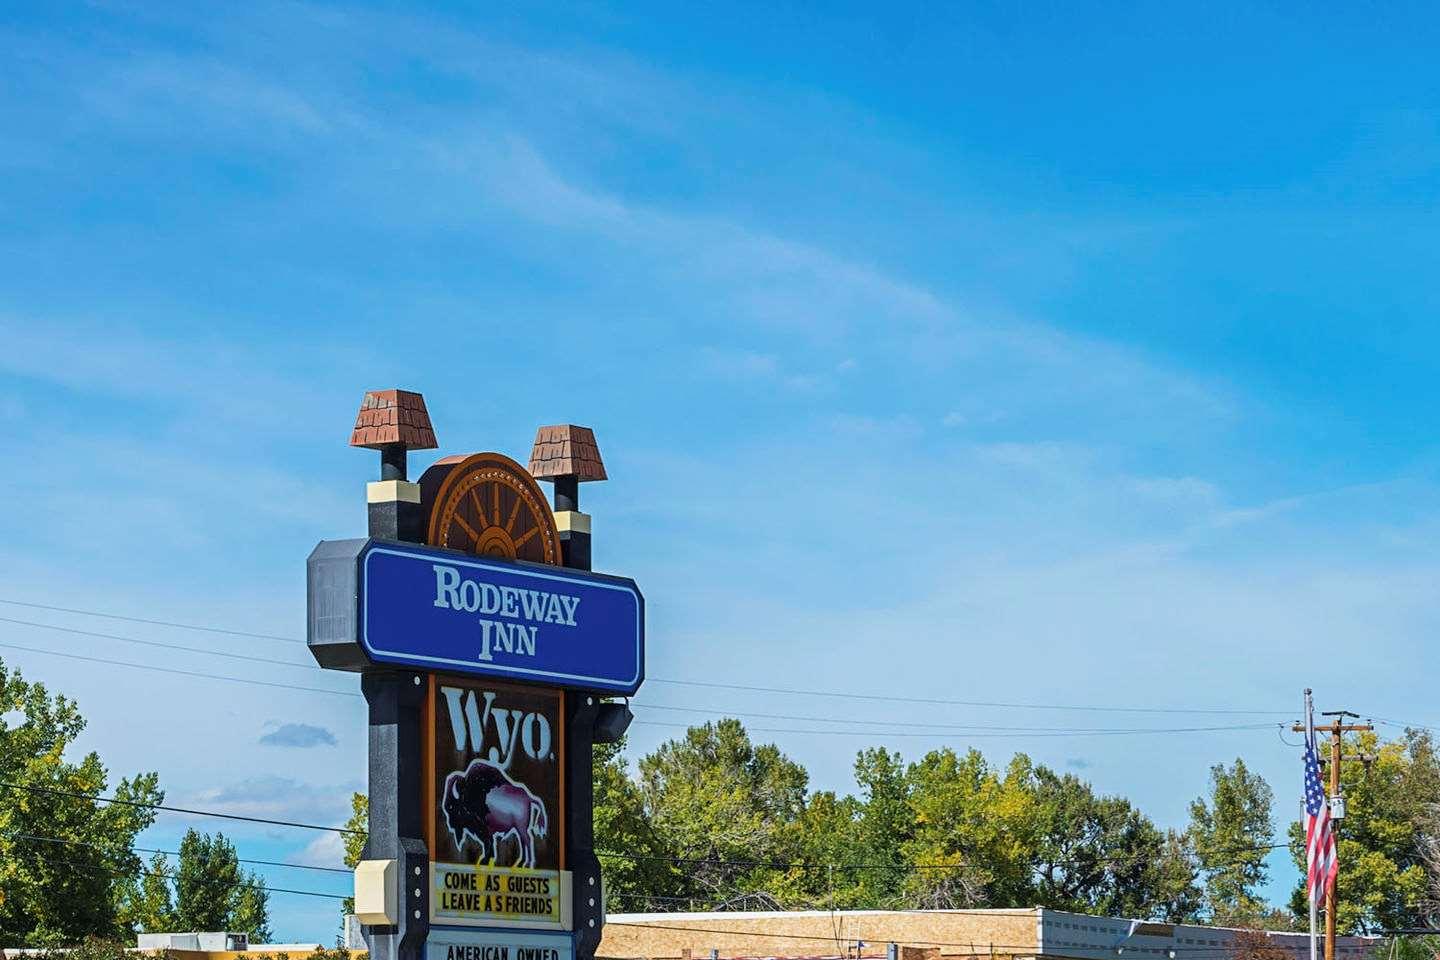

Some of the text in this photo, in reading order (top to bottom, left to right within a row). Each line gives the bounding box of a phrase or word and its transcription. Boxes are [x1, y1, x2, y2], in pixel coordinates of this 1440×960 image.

[433, 565, 580, 626] RODEWAY
[478, 619, 537, 661] INN
[445, 872, 549, 894] COME AS GUESTS
[442, 892, 480, 911] LEAVE
[506, 896, 553, 915] FRIENDS
